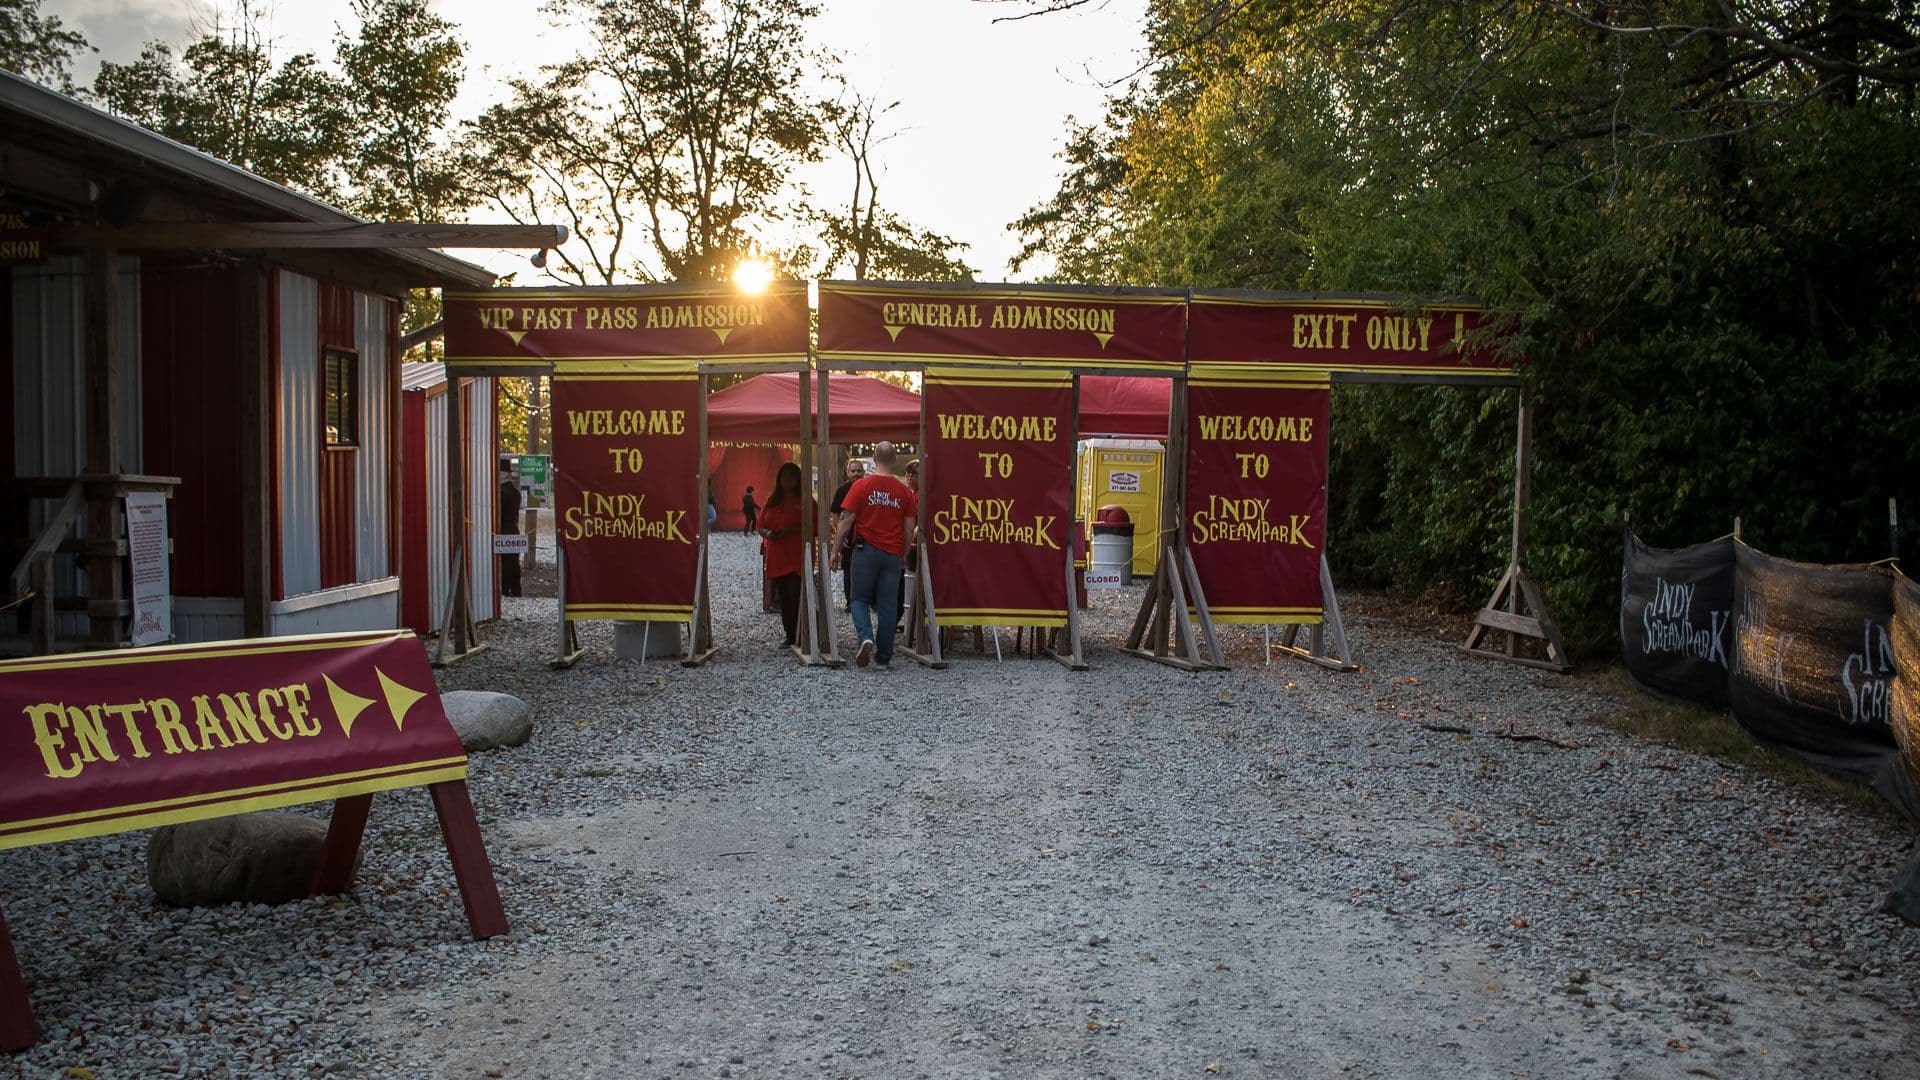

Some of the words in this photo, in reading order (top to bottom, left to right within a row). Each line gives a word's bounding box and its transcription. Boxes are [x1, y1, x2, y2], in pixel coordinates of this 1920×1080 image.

[479, 307, 514, 330] VIP
[522, 306, 578, 330] FAST
[585, 306, 638, 330] PASS
[645, 304, 764, 329] ADMISSION
[882, 302, 982, 328] GENERAL
[990, 305, 1115, 333] ADMISSION
[1292, 313, 1357, 349] EXIT
[1366, 315, 1433, 351] ONLY
[567, 410, 685, 436] WELCOME
[937, 414, 1057, 442] WELCOME
[1198, 415, 1313, 442] WELCOME
[608, 447, 643, 474] TO
[978, 451, 1014, 479] TO
[1236, 452, 1270, 479] TO
[582, 490, 645, 518] INDY
[949, 494, 1015, 522] INDY
[1208, 494, 1270, 522] INDY
[1086, 575, 1120, 584] CLOSED
[1651, 577, 1696, 621] INDY
[22, 682, 322, 779] ENTRANCE
